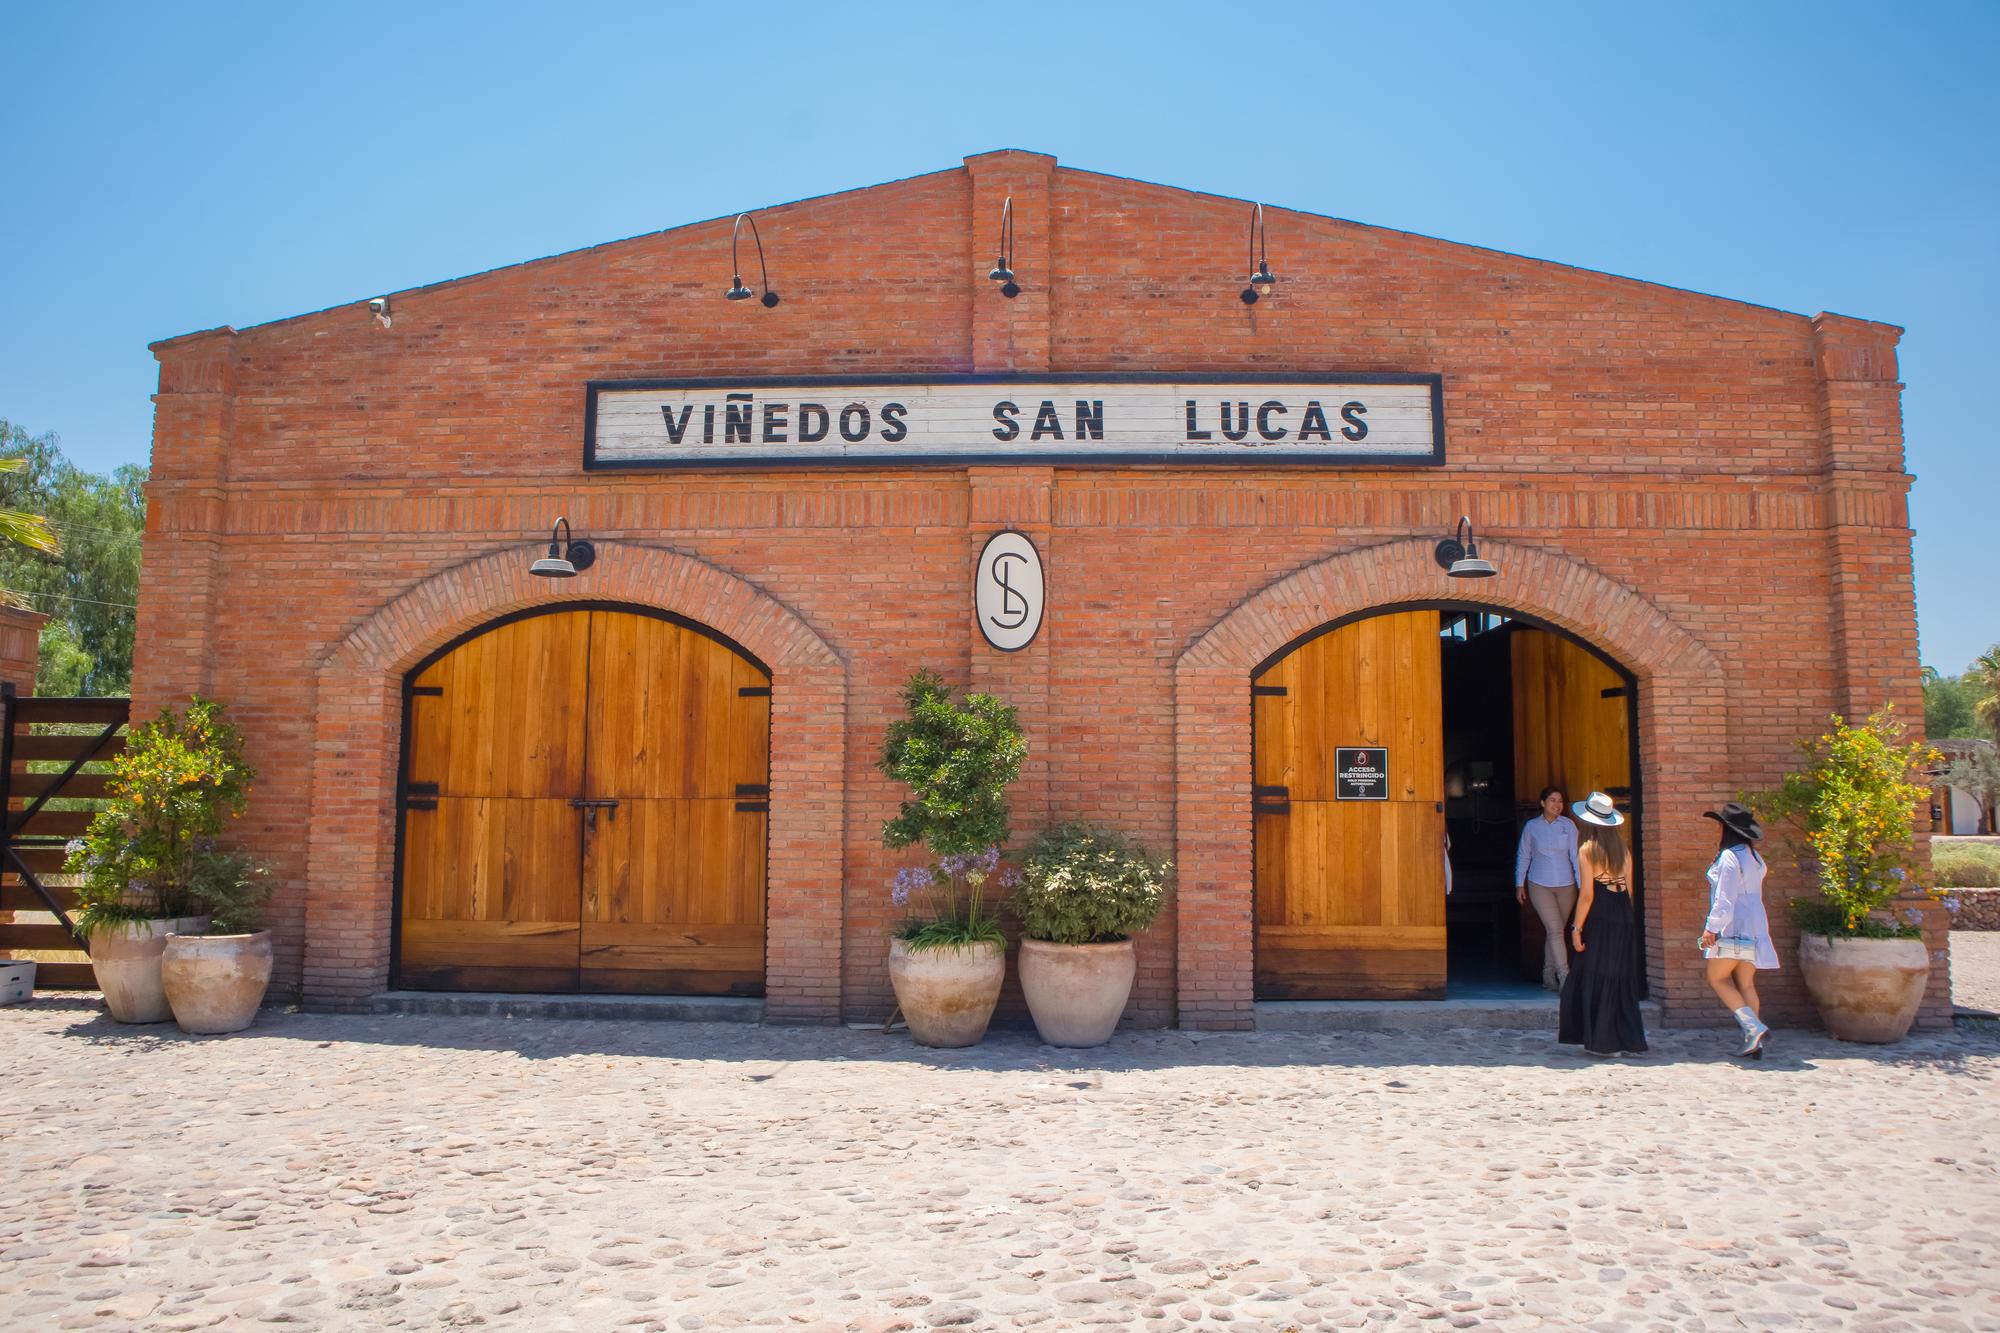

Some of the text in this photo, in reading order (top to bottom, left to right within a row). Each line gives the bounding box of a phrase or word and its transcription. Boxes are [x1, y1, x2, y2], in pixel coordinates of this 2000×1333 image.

[660, 393, 1369, 445] VIÑEDOS SAN LUCAS
